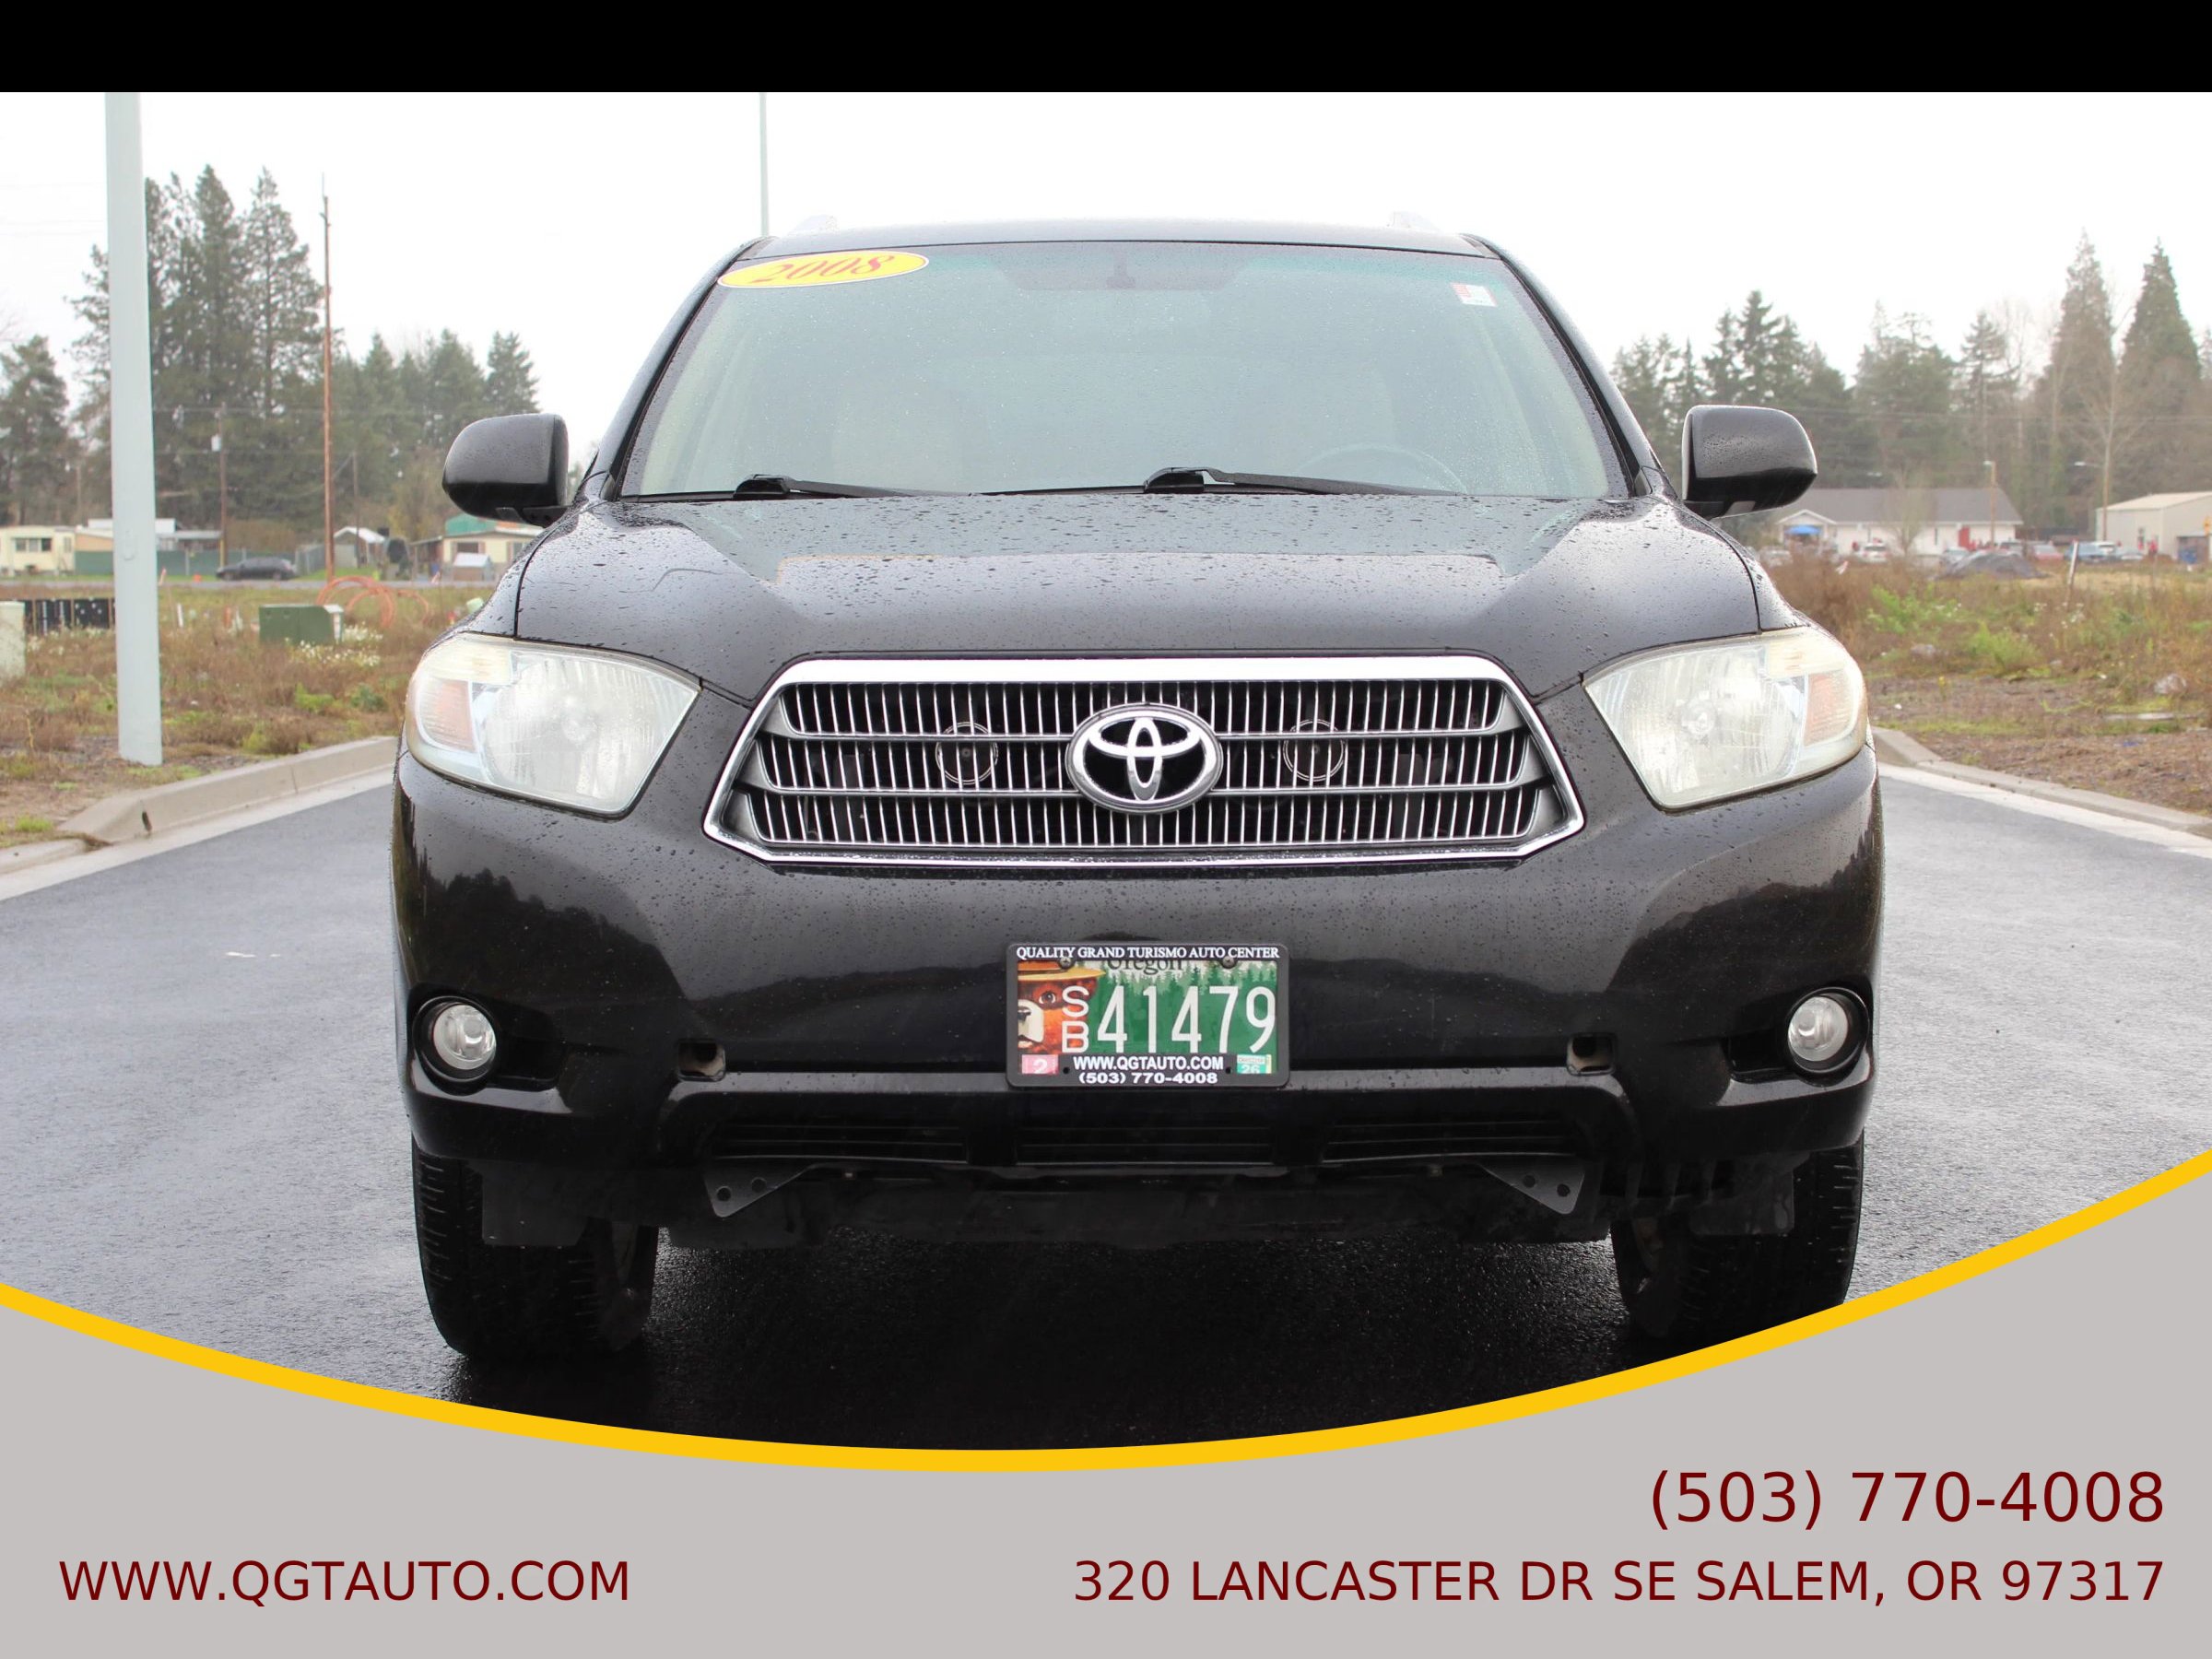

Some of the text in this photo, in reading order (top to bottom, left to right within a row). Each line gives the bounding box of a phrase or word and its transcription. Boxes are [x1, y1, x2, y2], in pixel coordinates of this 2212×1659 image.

[750, 255, 895, 283] 2008
[1016, 947, 1280, 959] QUALITY GRAND TURISMO AUTO CENTER
[1097, 985, 1276, 1053] 41479
[1073, 1056, 1224, 1071] WWW.QGTAUTO.COM
[1078, 1072, 1218, 1084] (503) 770-4008
